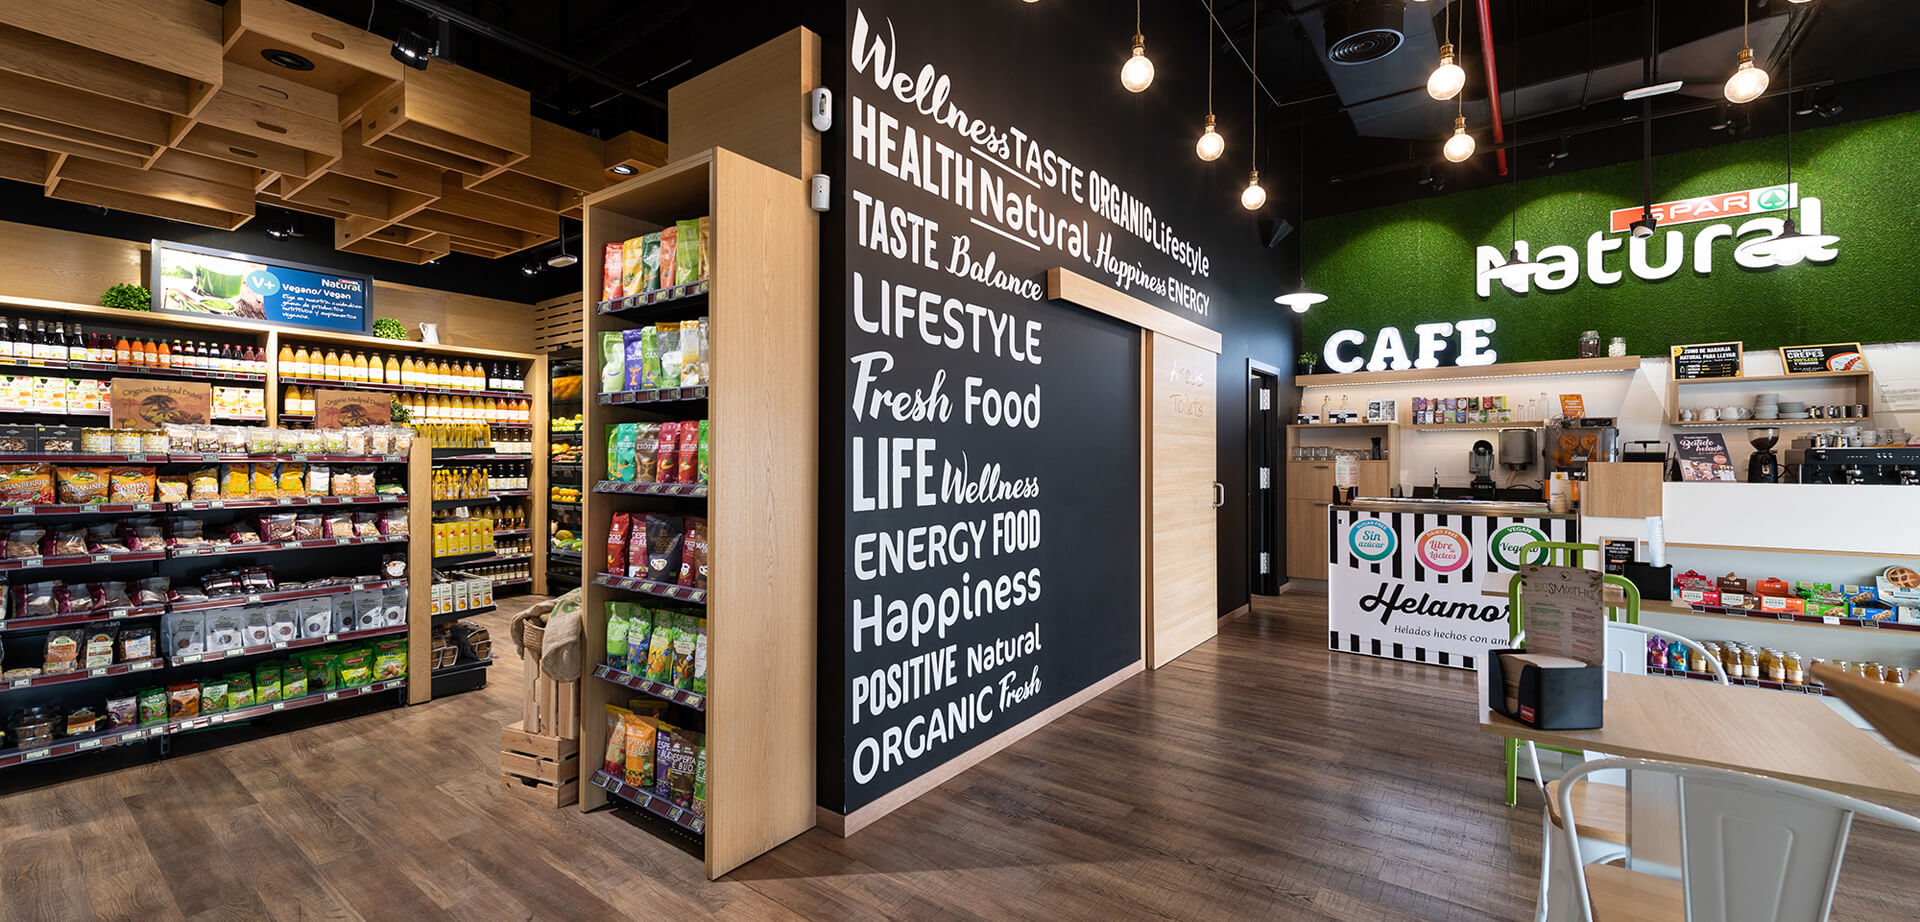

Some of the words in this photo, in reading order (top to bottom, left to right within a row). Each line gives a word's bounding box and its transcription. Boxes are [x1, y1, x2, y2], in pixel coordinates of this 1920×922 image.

[851, 8, 1010, 160] Wellness
[1009, 126, 1084, 203] TASTE
[1089, 170, 1152, 241] ORGANIC
[1152, 218, 1209, 277] Lifestyle
[852, 96, 973, 210] HEALTH
[980, 168, 1091, 263] Natural
[1093, 231, 1167, 297] Happiness
[1168, 276, 1210, 316] ENERGY
[1648, 194, 1748, 223] SPAR
[852, 189, 938, 270] TASTE
[945, 235, 1043, 301] Balance
[1476, 197, 1839, 298] Natural
[252, 276, 275, 290] V+
[282, 283, 321, 295] Vegano/
[324, 290, 351, 300] Vegan
[322, 279, 361, 292] Natural
[853, 272, 1042, 365] LIFESTYLE
[1323, 318, 1497, 373] CAFE
[122, 387, 151, 397] Organic
[851, 351, 952, 423] Fresh
[965, 377, 1040, 429] Food
[852, 436, 936, 512] LIFE
[941, 450, 1039, 504] Wellness
[854, 520, 986, 580] ENERGY
[993, 509, 1040, 556] FOOD
[1362, 530, 1381, 541] Sin
[1429, 540, 1453, 550] Libre
[1444, 530, 1458, 538] FREE
[853, 568, 1041, 653] Happiness
[1394, 625, 1431, 637] Helados
[1433, 628, 1467, 641] hechos
[1469, 635, 1488, 645] con
[852, 644, 957, 725] POSITIVE
[967, 622, 1042, 678] Natural
[853, 686, 993, 785] ORGANIC
[998, 665, 1042, 712] Fresh
